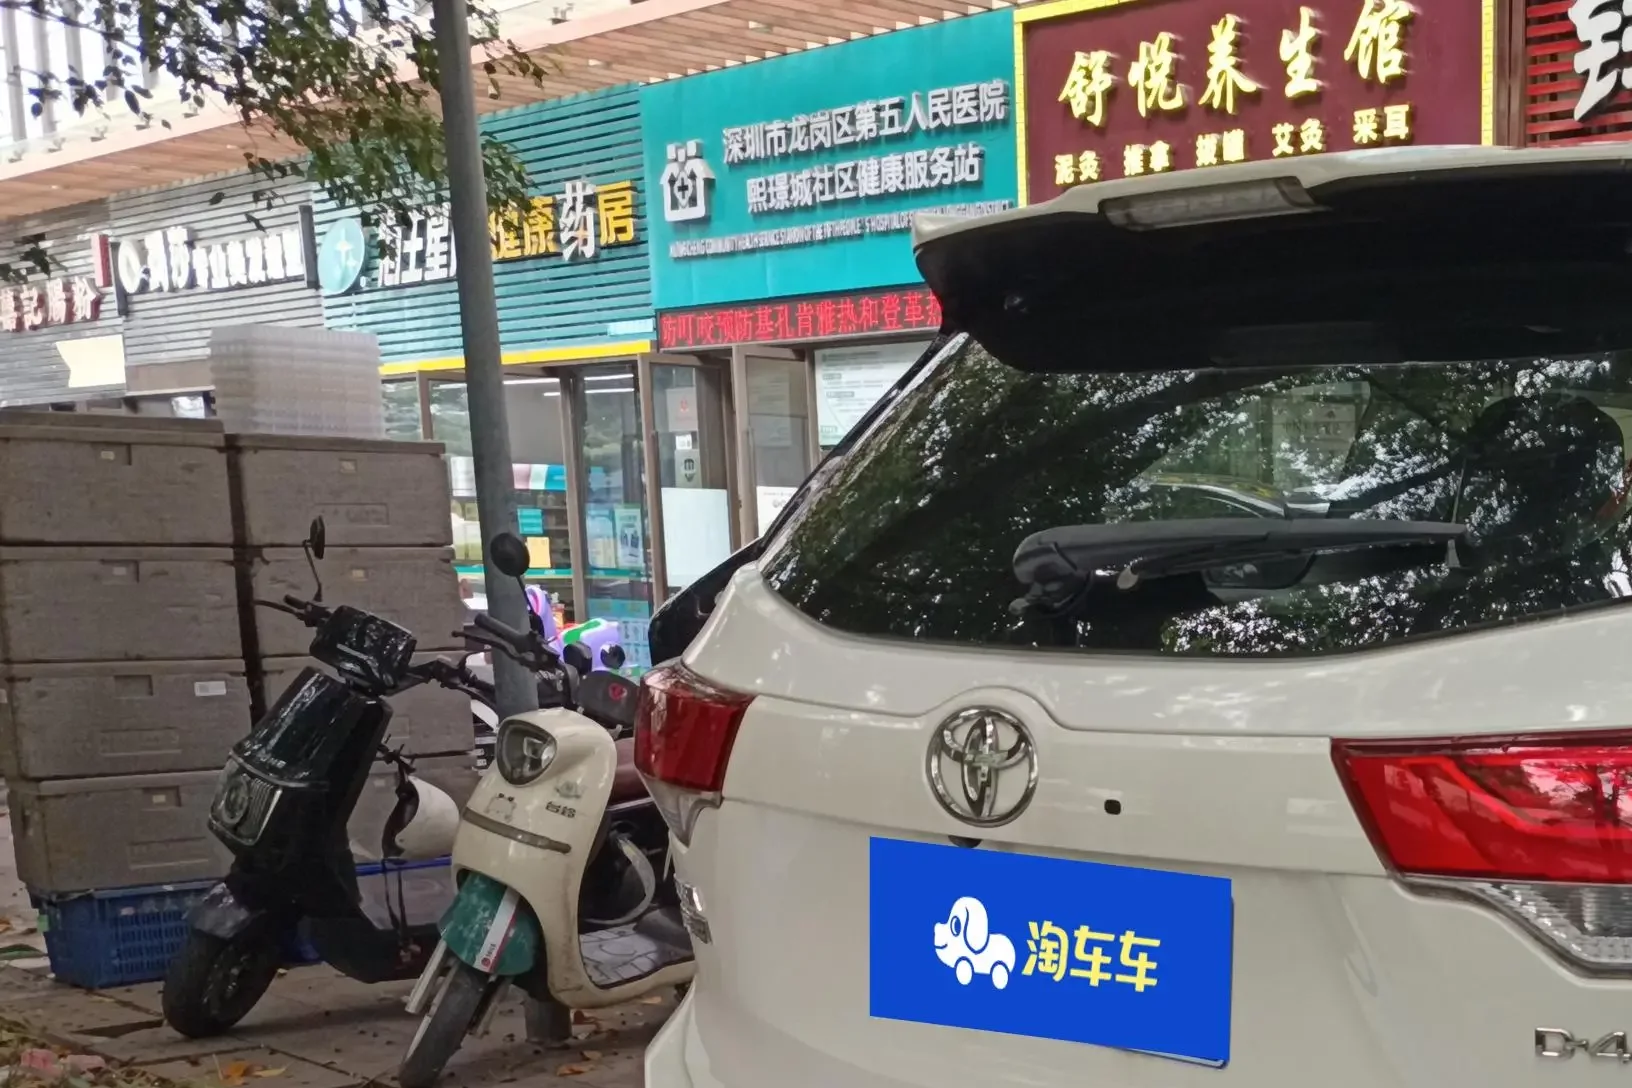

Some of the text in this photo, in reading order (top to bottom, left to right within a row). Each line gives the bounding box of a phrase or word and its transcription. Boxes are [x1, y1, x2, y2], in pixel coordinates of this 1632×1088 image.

[1058, 0, 1412, 127] 舒悦养生馆
[723, 81, 1006, 163] 深圳市龙岗区第五人民医院
[1272, 119, 1324, 157] 艾灸
[1353, 105, 1411, 144] 采耳
[747, 143, 981, 213] 熙璟城社区健康服务站
